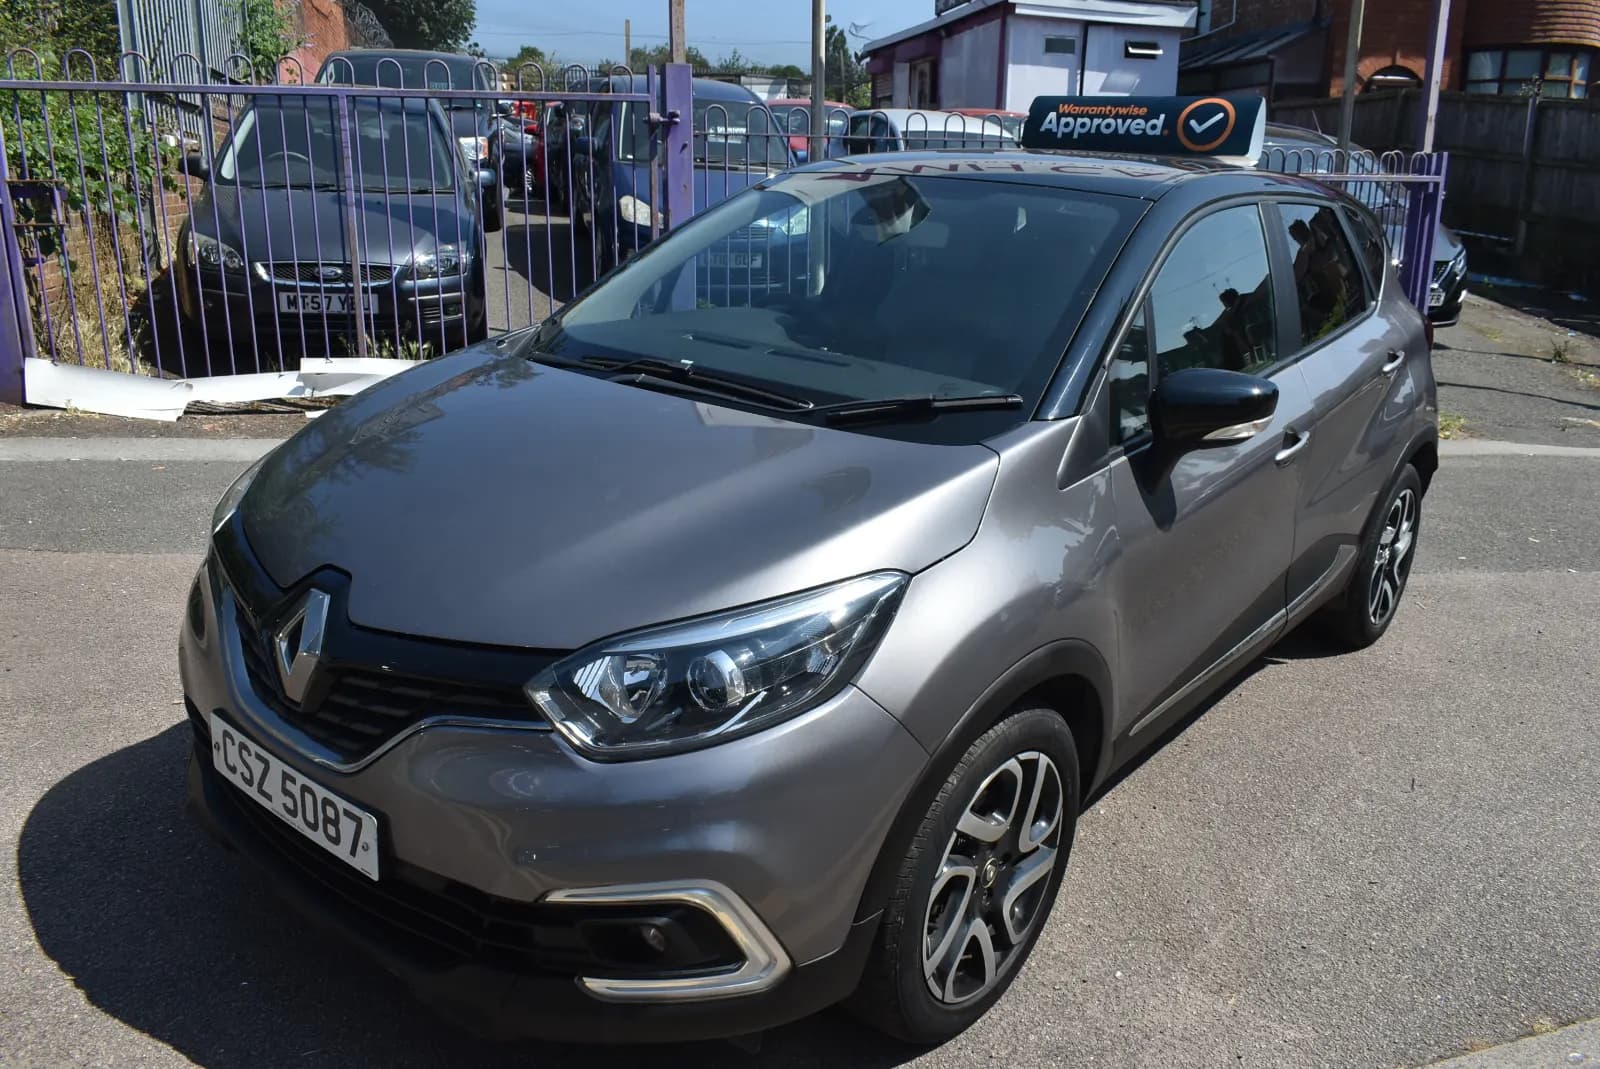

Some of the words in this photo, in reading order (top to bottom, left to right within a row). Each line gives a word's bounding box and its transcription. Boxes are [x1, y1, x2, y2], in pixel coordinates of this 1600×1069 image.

[1059, 103, 1148, 116] Warrantywise
[287, 295, 332, 312] MT57
[222, 729, 273, 804] CSZ
[281, 769, 363, 859] 5087
